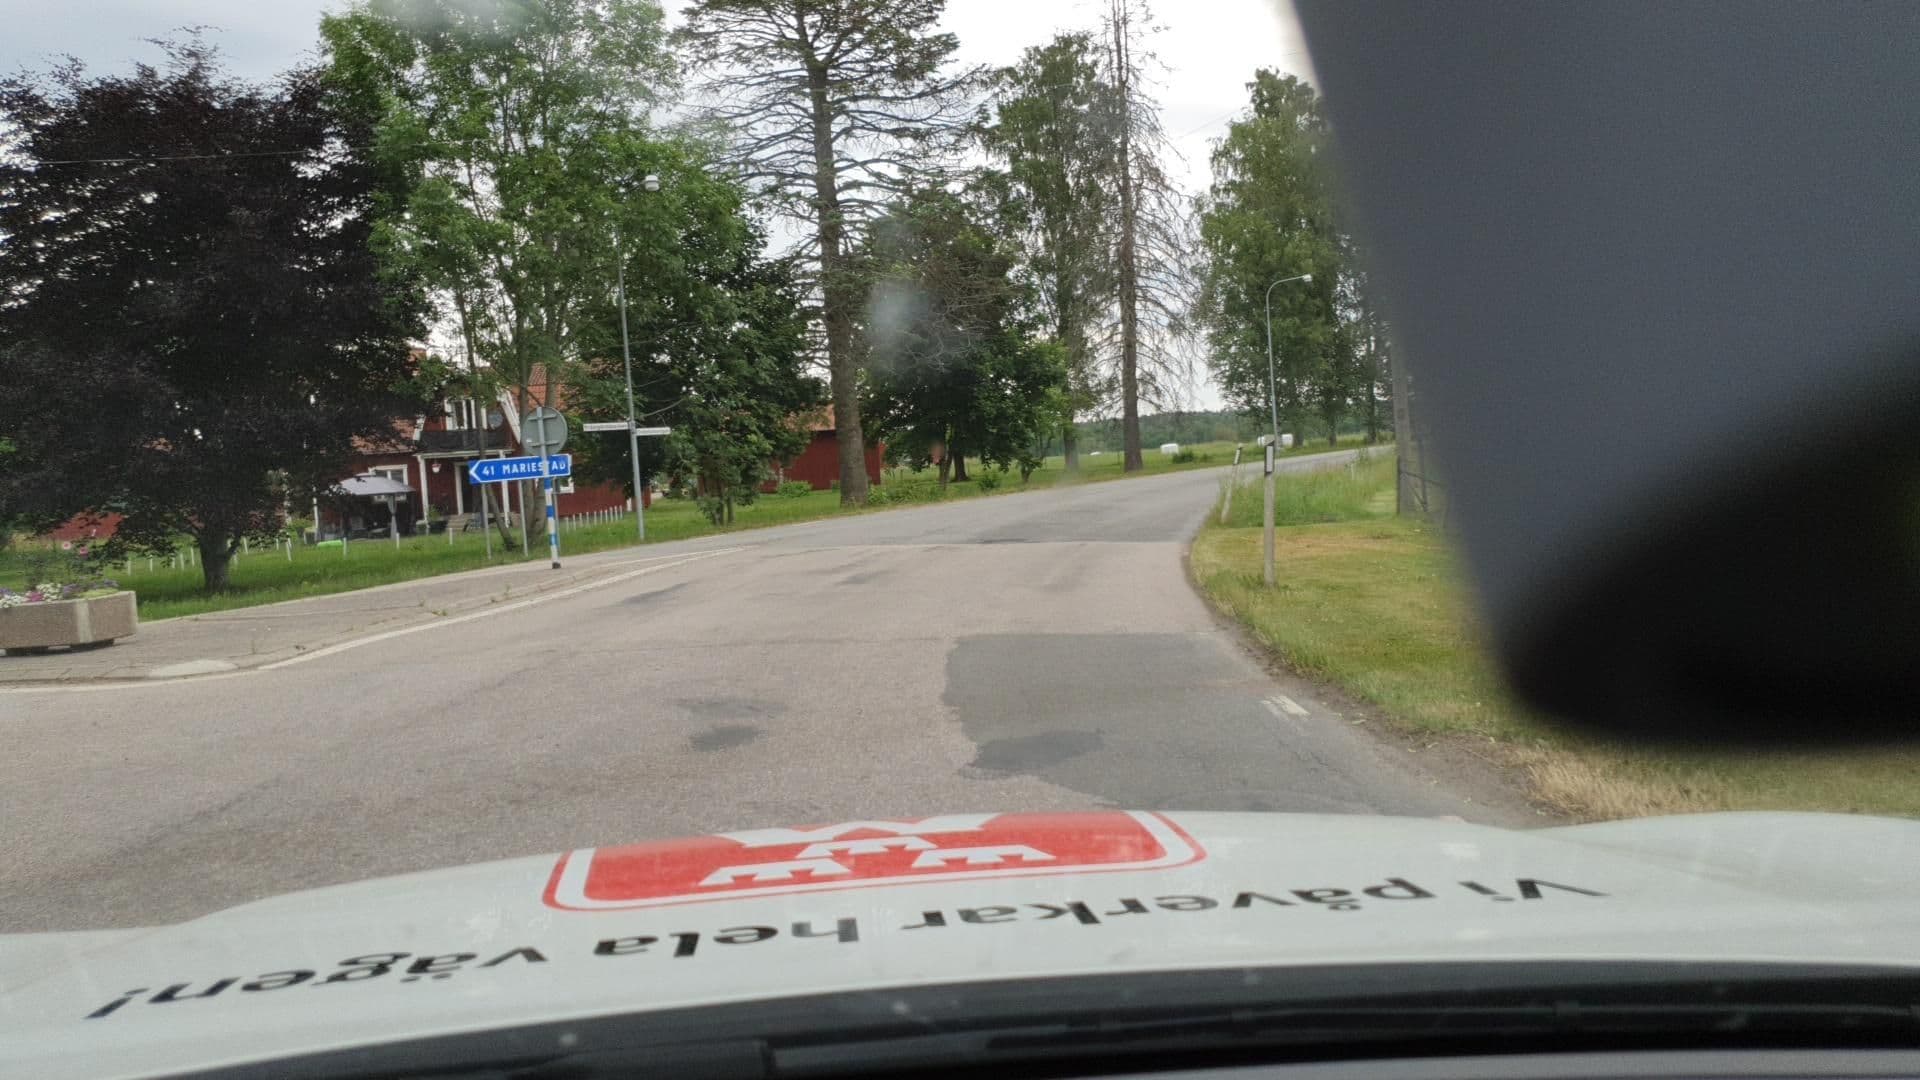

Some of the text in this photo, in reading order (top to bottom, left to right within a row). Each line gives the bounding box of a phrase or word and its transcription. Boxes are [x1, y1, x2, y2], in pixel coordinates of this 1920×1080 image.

[482, 460, 566, 476] 41 MARIESAD
[86, 876, 1611, 1020] Vi påverkar hela vägen!
